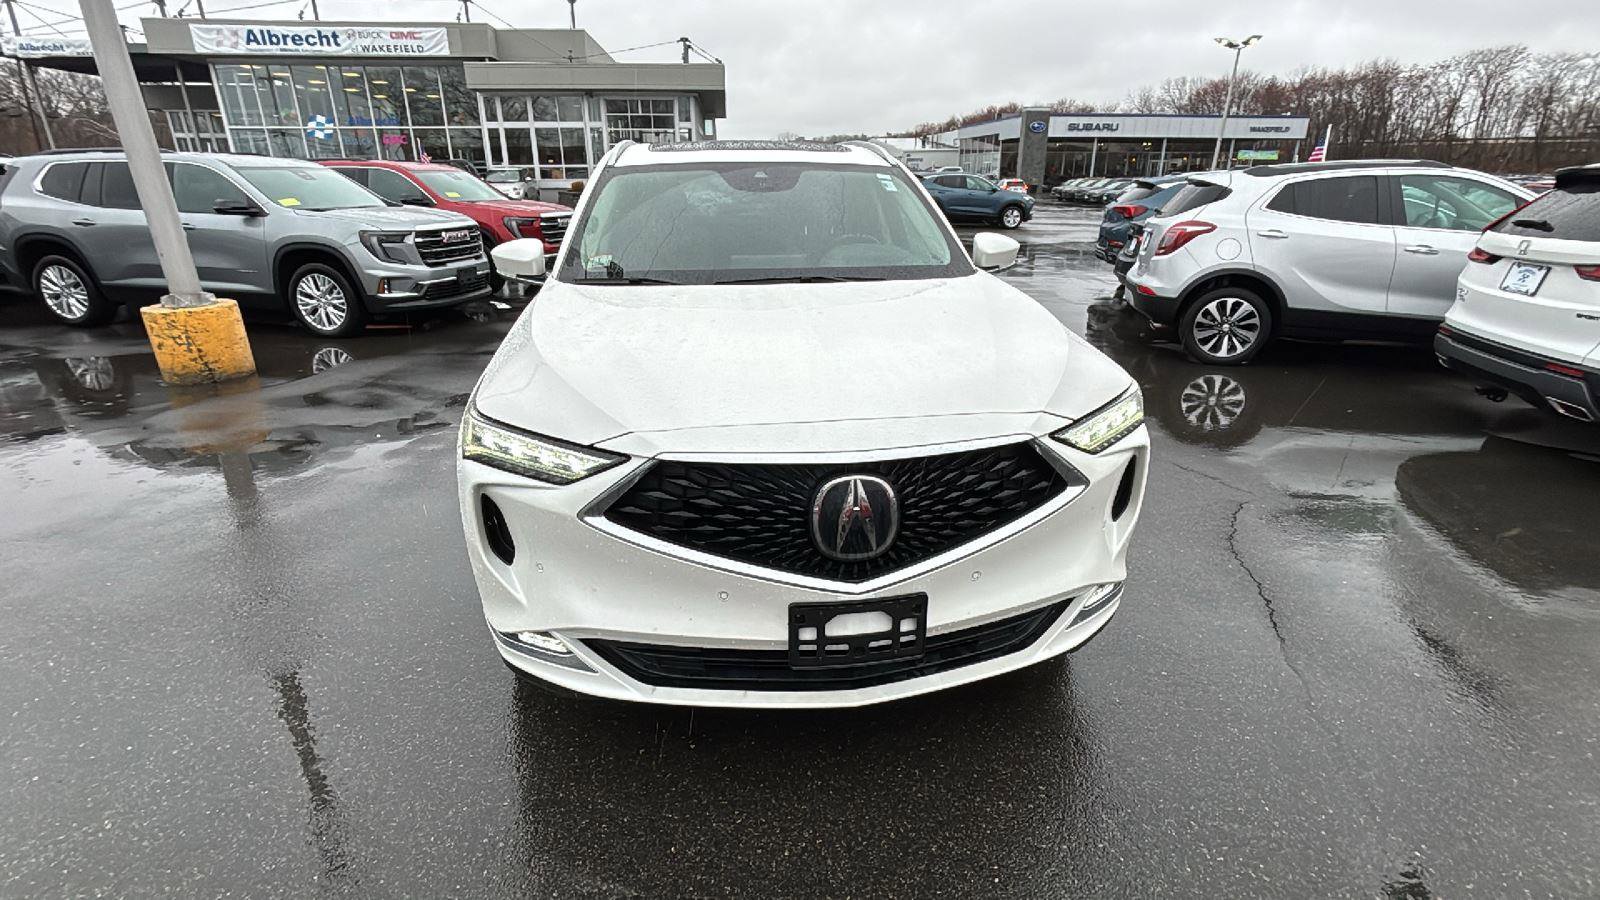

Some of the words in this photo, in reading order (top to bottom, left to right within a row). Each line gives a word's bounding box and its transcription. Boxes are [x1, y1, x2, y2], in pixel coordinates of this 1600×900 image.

[245, 28, 341, 47] Albrecht
[389, 31, 422, 40] GMC
[18, 42, 65, 52] Albrecht
[361, 44, 424, 54] WAKEFIELD
[1067, 122, 1120, 131] SUBARU
